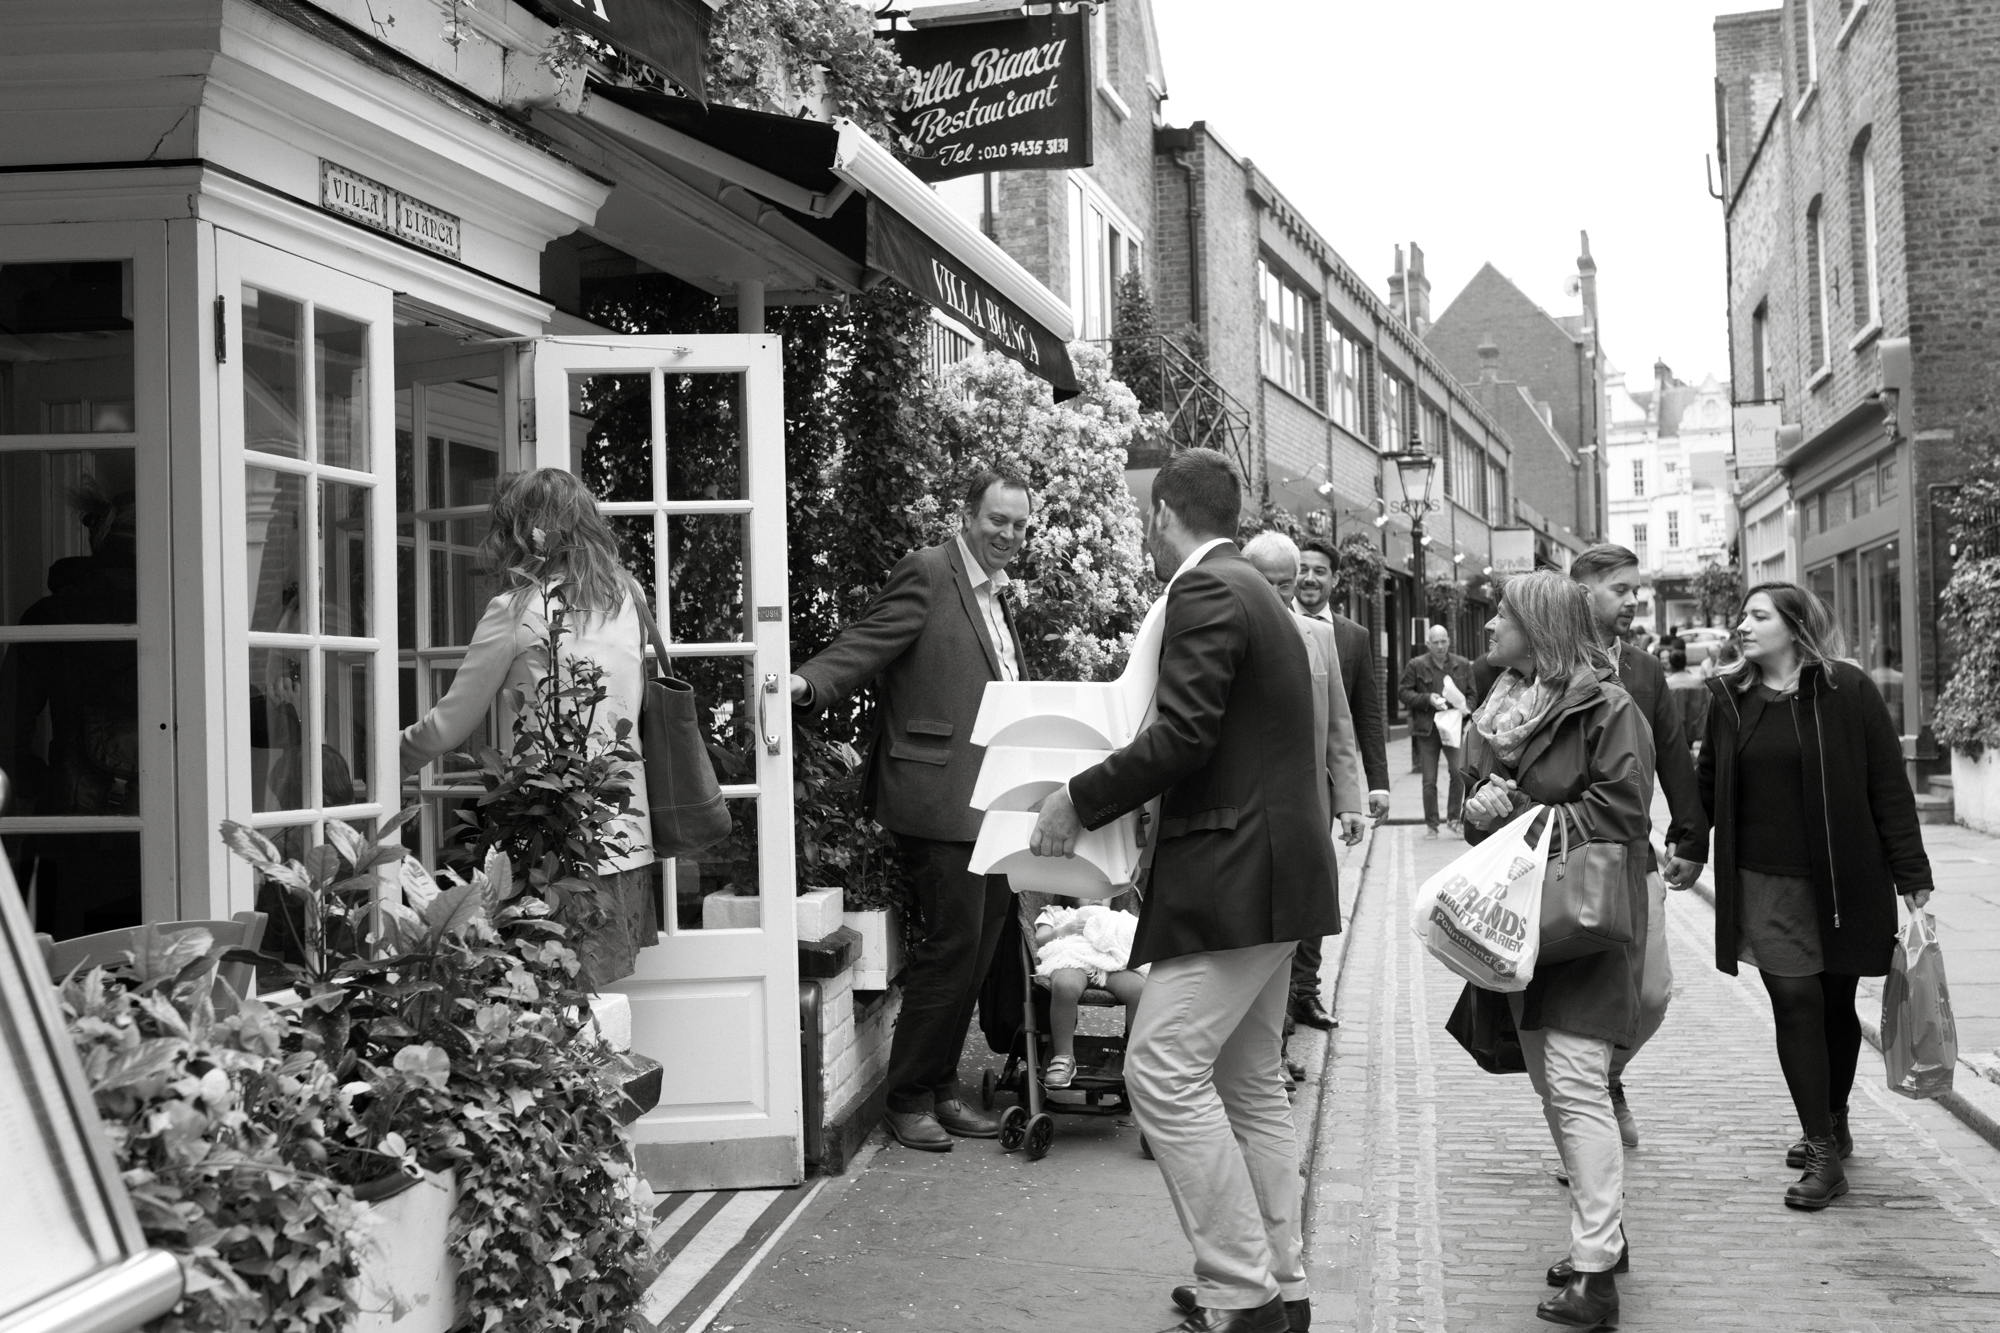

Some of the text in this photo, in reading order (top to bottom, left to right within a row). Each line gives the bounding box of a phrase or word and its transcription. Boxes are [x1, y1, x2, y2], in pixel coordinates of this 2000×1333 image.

[965, 39, 1067, 93] Bianca
[908, 74, 1059, 144] Restaurant
[1010, 139, 1044, 157] 7435
[1046, 137, 1069, 155] 3131
[333, 176, 454, 247] VILLA BIANCA
[931, 257, 1040, 366] VILLA BIANCA
[761, 609, 779, 618] PUSH
[1436, 889, 1475, 927] QUALITY
[1472, 921, 1483, 934] &
[1443, 874, 1527, 941] BRANDS
